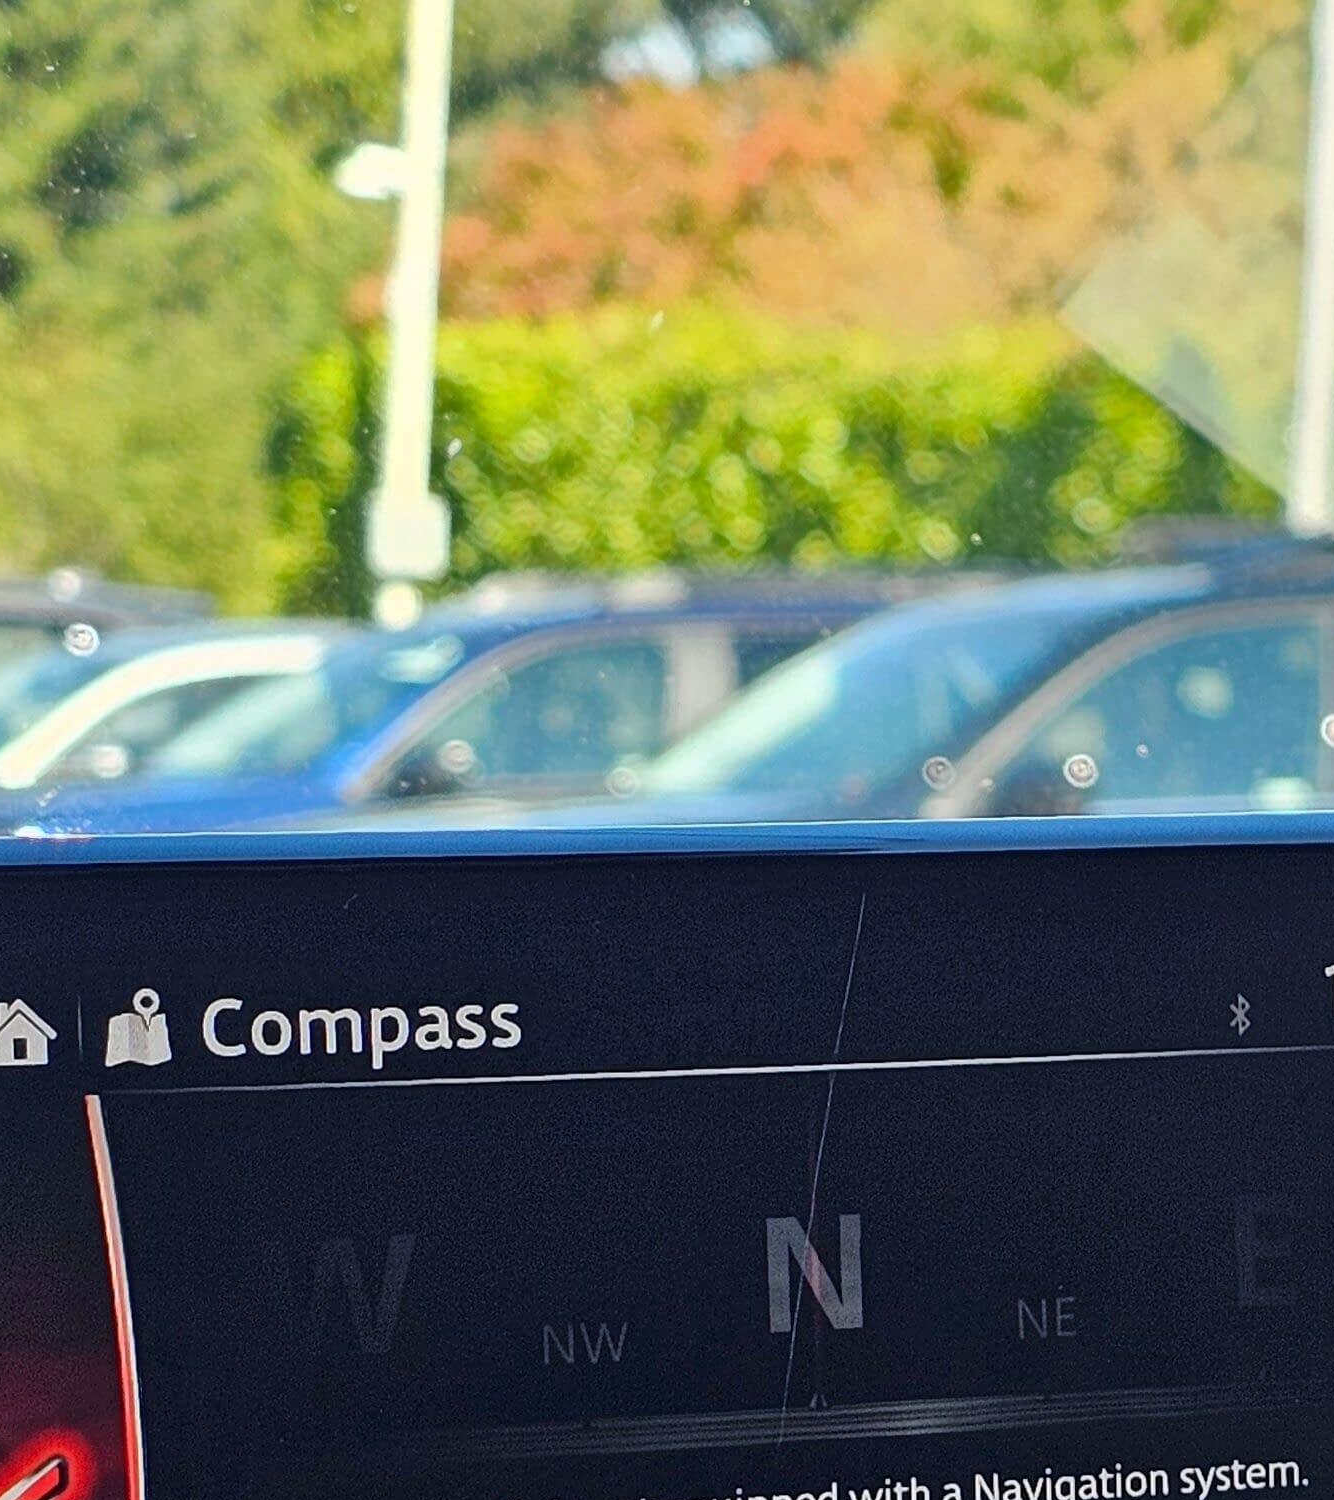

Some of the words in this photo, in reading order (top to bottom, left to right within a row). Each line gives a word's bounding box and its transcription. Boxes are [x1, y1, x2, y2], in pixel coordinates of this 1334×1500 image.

[201, 997, 523, 1070] Compass
[764, 1212, 865, 1334] N
[541, 1321, 628, 1364] NW
[1016, 1296, 1077, 1340] NE
